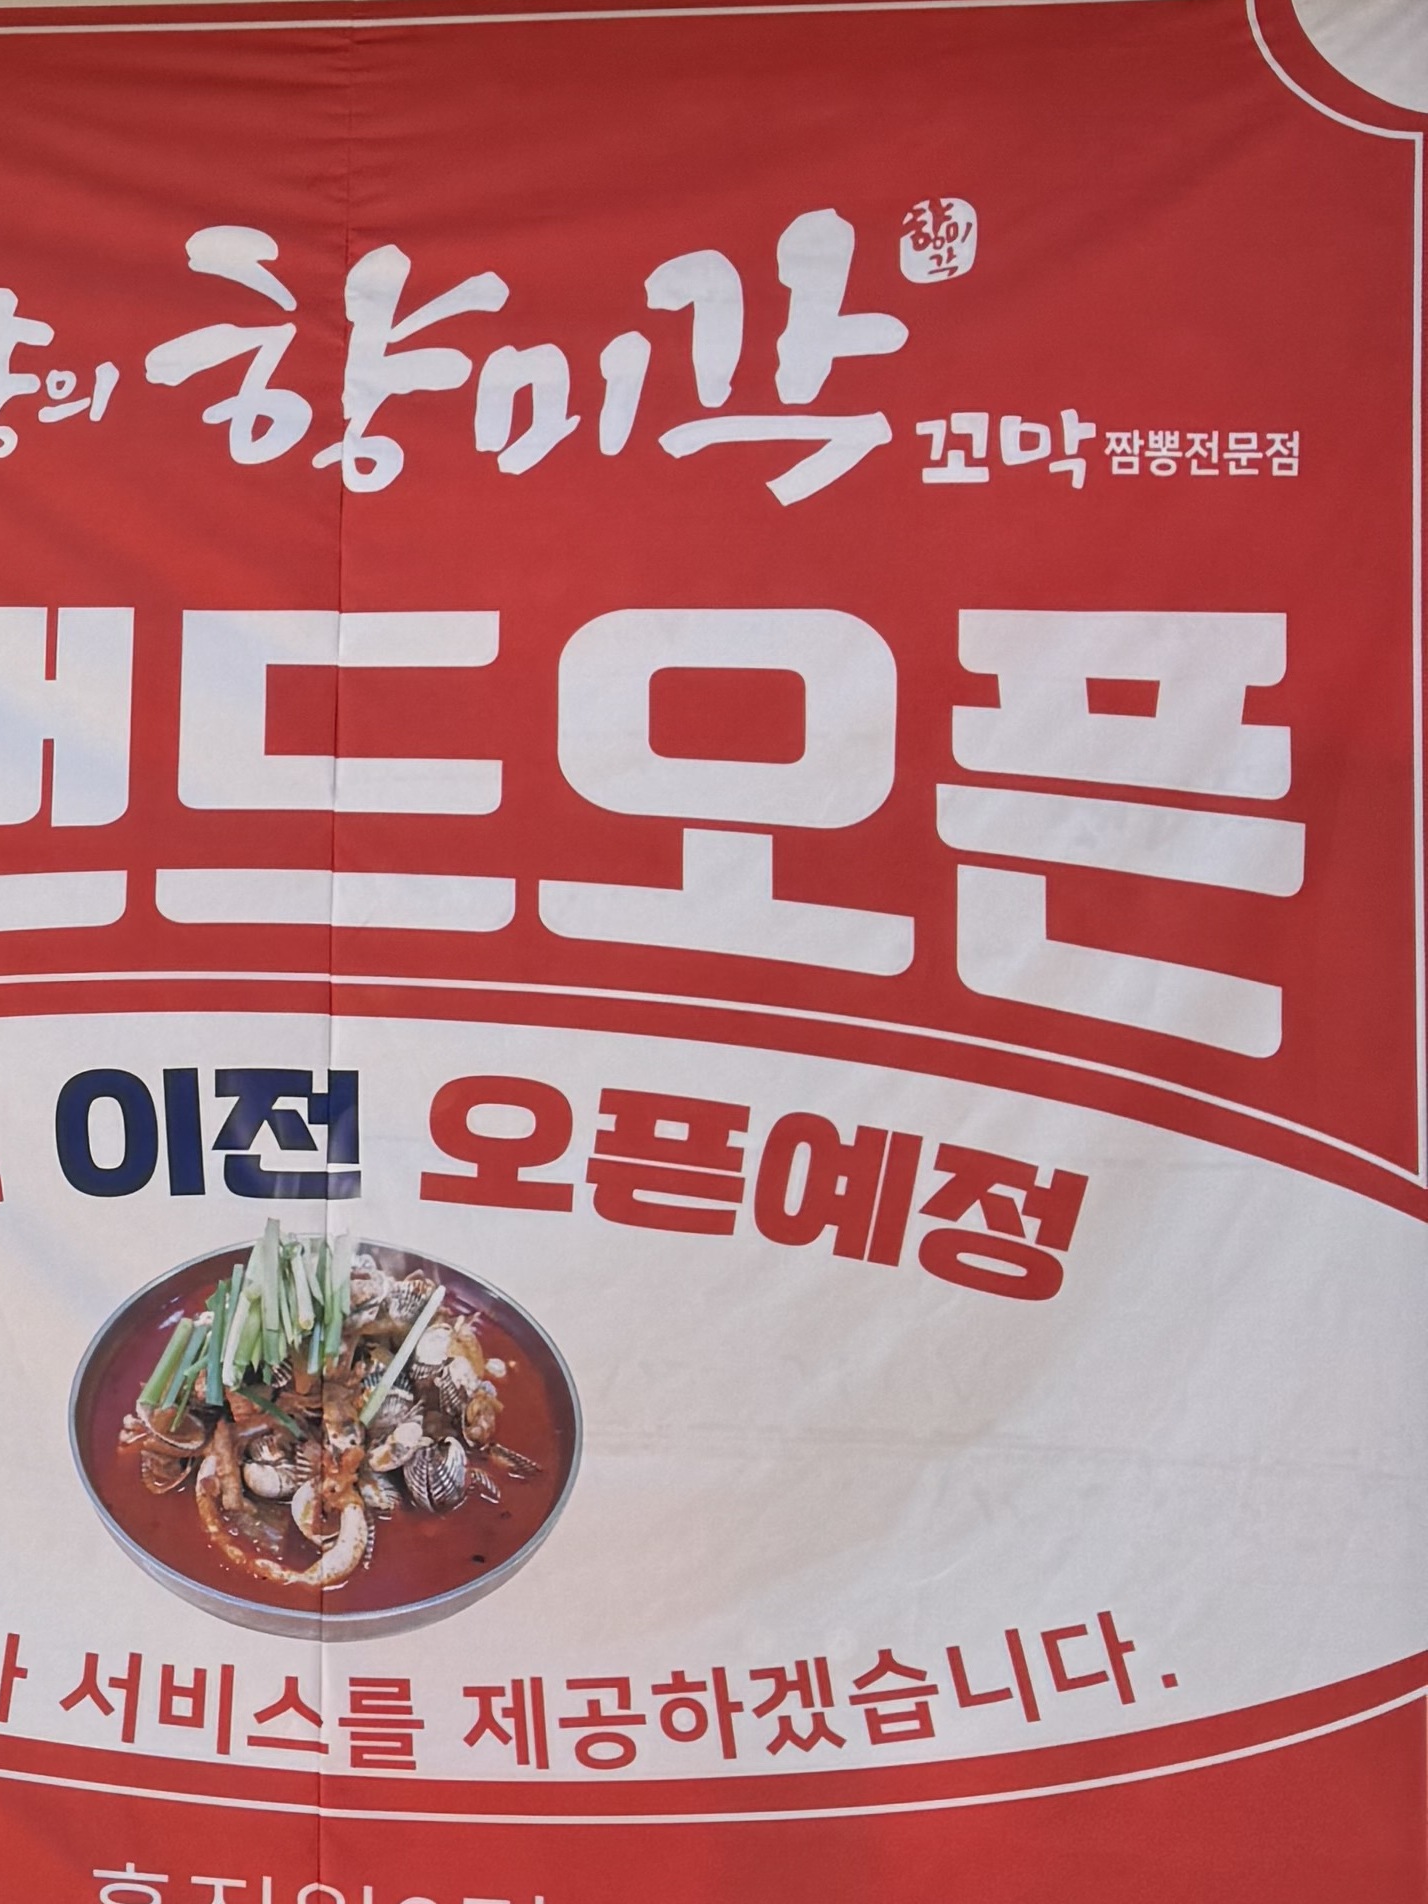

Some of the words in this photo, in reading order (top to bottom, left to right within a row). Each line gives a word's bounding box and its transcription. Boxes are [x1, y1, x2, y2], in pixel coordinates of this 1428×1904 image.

[144, 207, 915, 507] 향미각
[915, 408, 1097, 490] 꼬막
[1104, 429, 1301, 477] 짬뽕전문점
[54, 1067, 362, 1201] 이전
[419, 1074, 1088, 1301] 오픈예정
[59, 1646, 425, 1772] 서비스를
[461, 1609, 1179, 1772] 제공하겠습니다.
